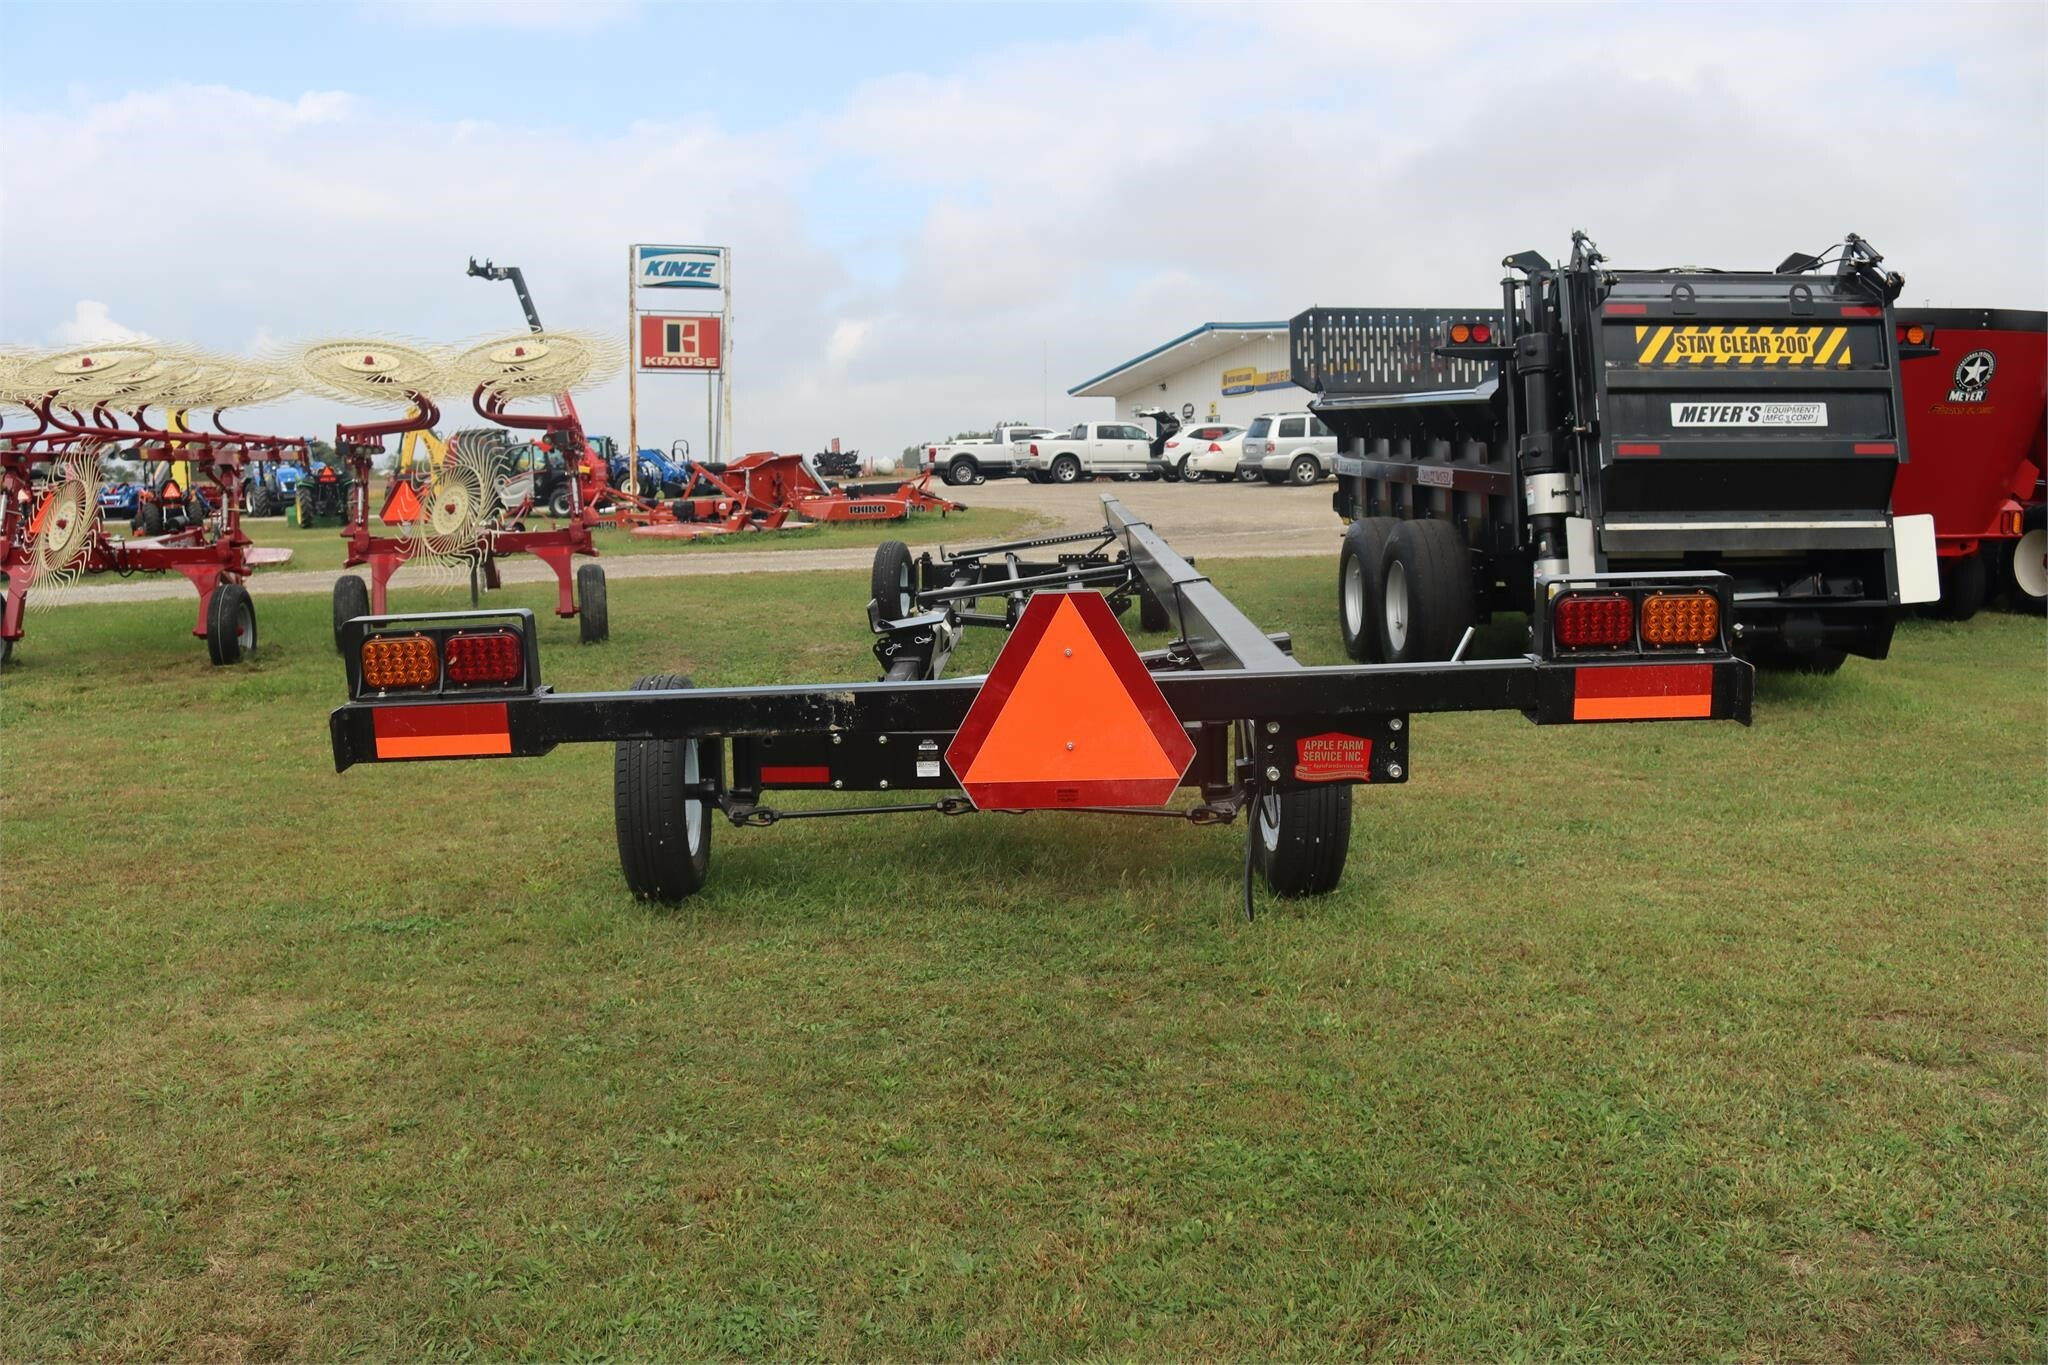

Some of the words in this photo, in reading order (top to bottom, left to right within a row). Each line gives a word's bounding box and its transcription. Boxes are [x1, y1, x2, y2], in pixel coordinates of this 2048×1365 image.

[645, 261, 716, 278] KINZE
[1676, 335, 1715, 354] STAY
[1720, 335, 1772, 354] CLEAR
[645, 356, 718, 366] KRAUSE
[1949, 390, 1984, 401] MEYER
[1679, 405, 1762, 423] MEYER'S
[1767, 406, 1817, 414] EQUIPMENT
[849, 505, 886, 514] RHINO
[1305, 740, 1334, 750] APPLE
[1337, 740, 1364, 750] FARM
[1303, 751, 1342, 762] SERVICE
[1345, 751, 1364, 762] INC.
